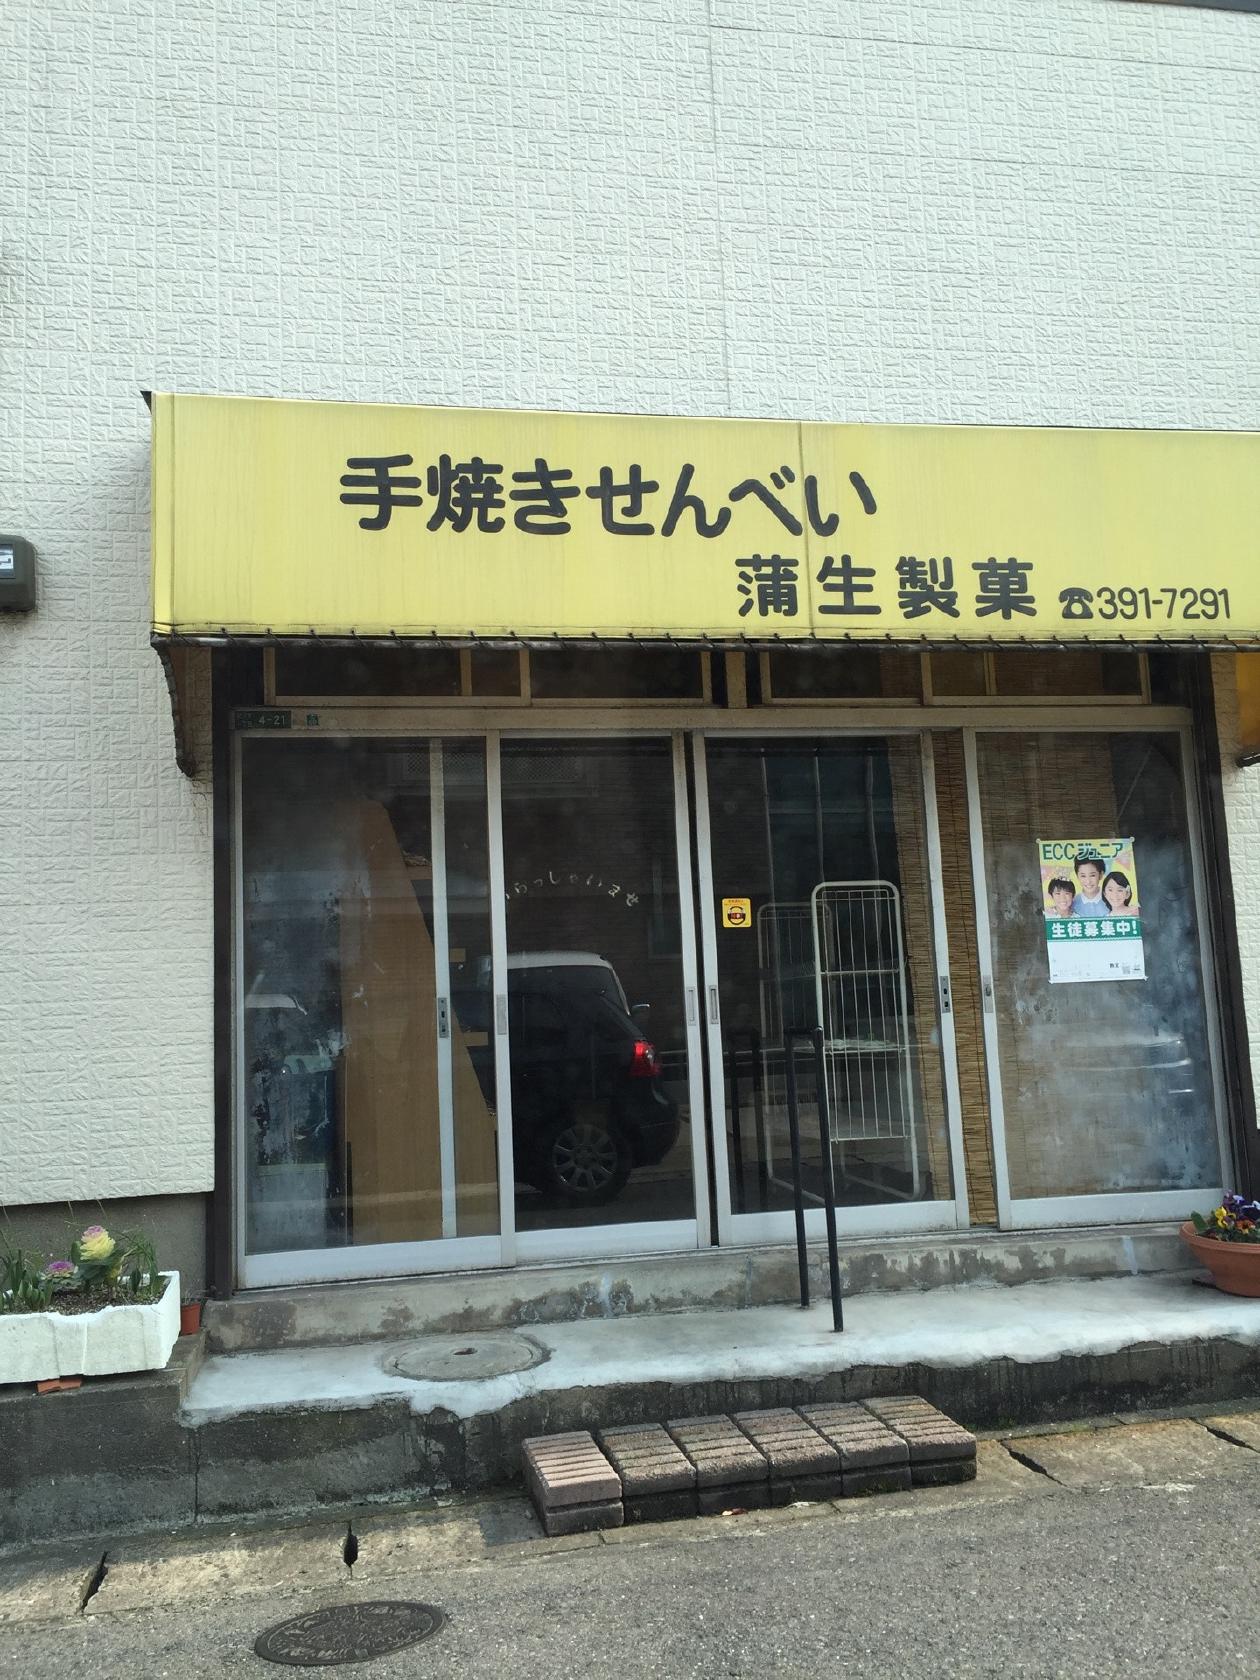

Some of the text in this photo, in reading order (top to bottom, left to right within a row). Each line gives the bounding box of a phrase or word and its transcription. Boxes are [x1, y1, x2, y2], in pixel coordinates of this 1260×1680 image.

[340, 453, 877, 538] 手焼きせんべい
[735, 553, 1231, 620] 蒲生製菓 391-7291
[258, 715, 285, 725] 4-21
[1051, 920, 1138, 938] 生徒募集中!
